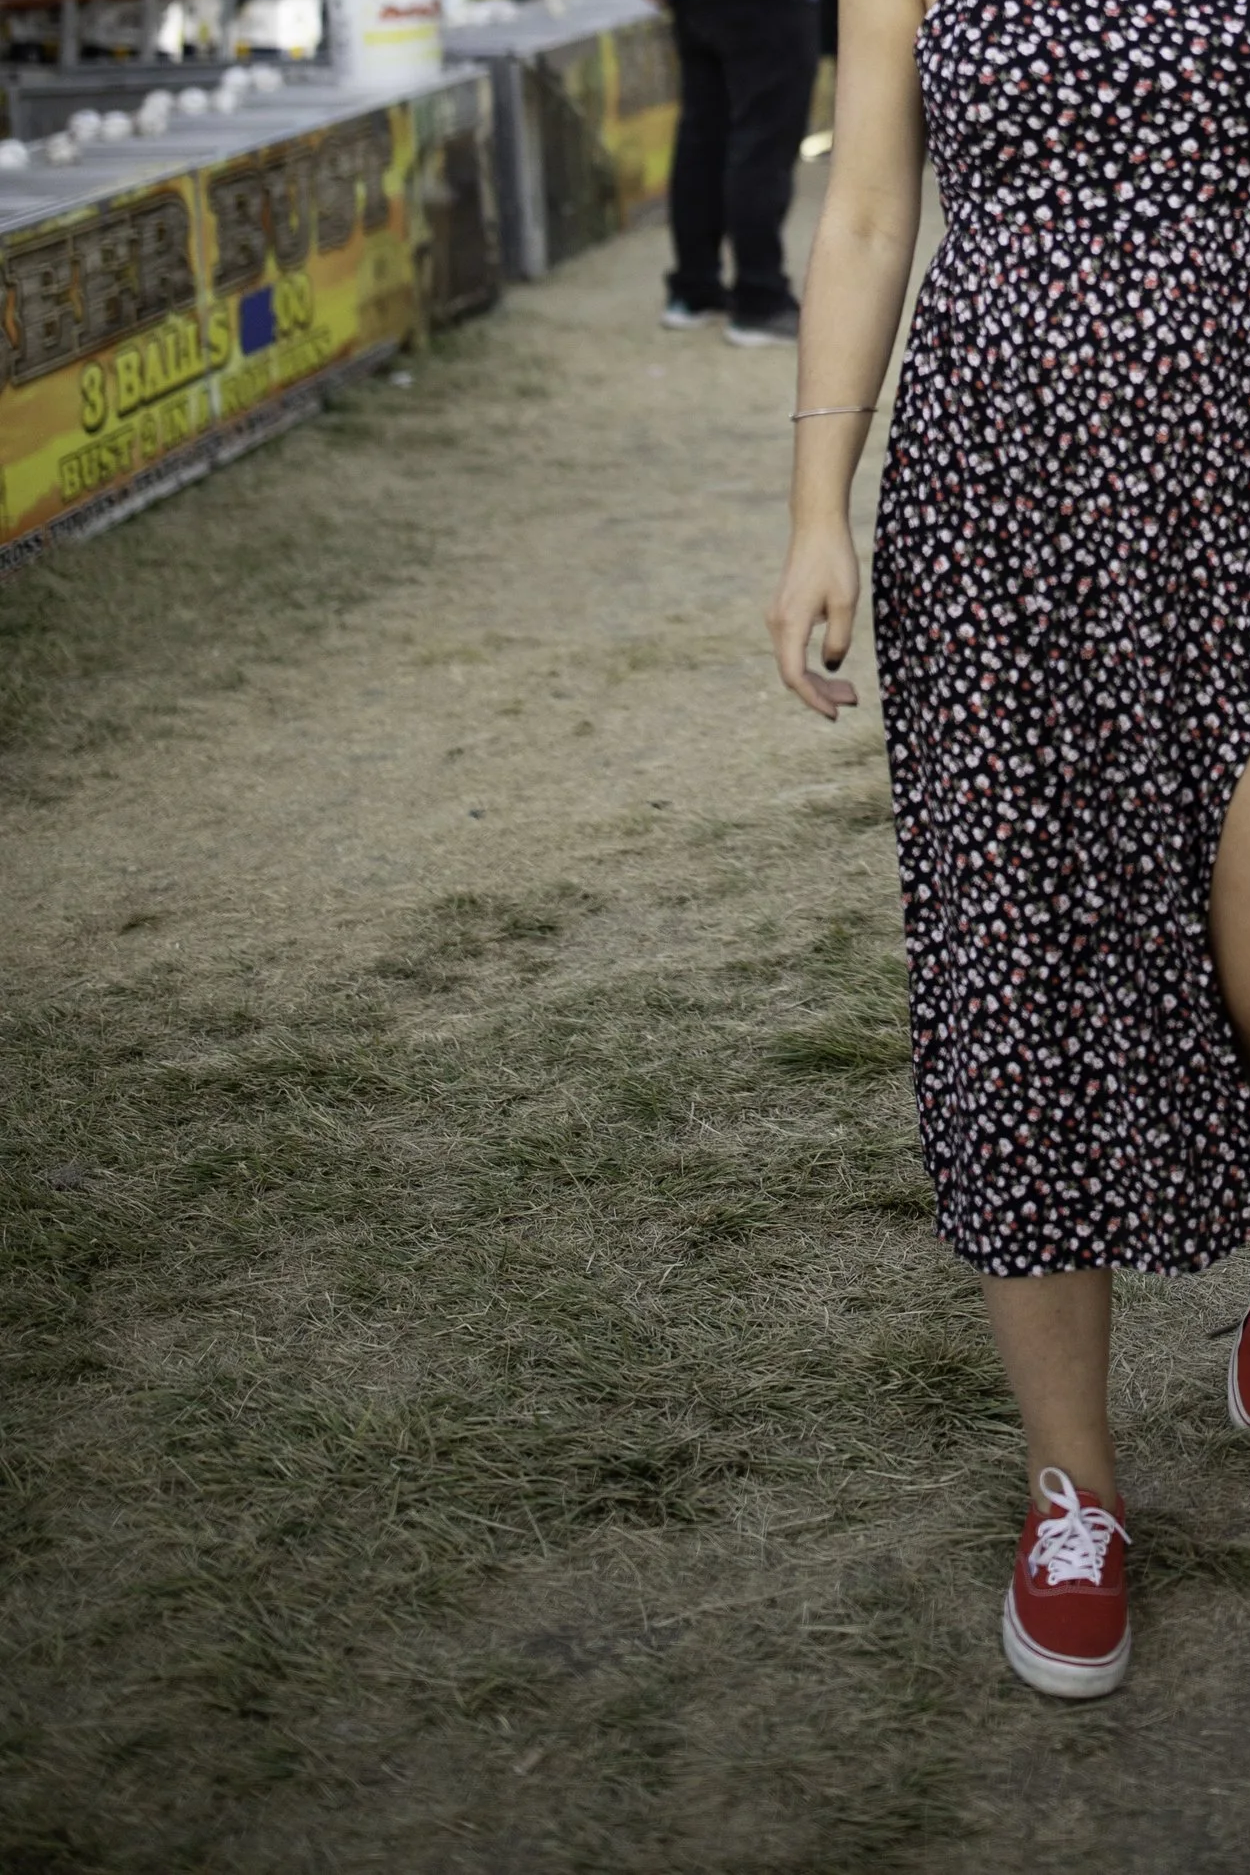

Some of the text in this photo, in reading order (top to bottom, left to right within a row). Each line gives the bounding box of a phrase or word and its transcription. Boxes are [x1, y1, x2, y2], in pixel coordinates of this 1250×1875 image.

[0, 189, 199, 390] EER
[114, 309, 229, 417] BALLS
[58, 422, 137, 506] BUST
